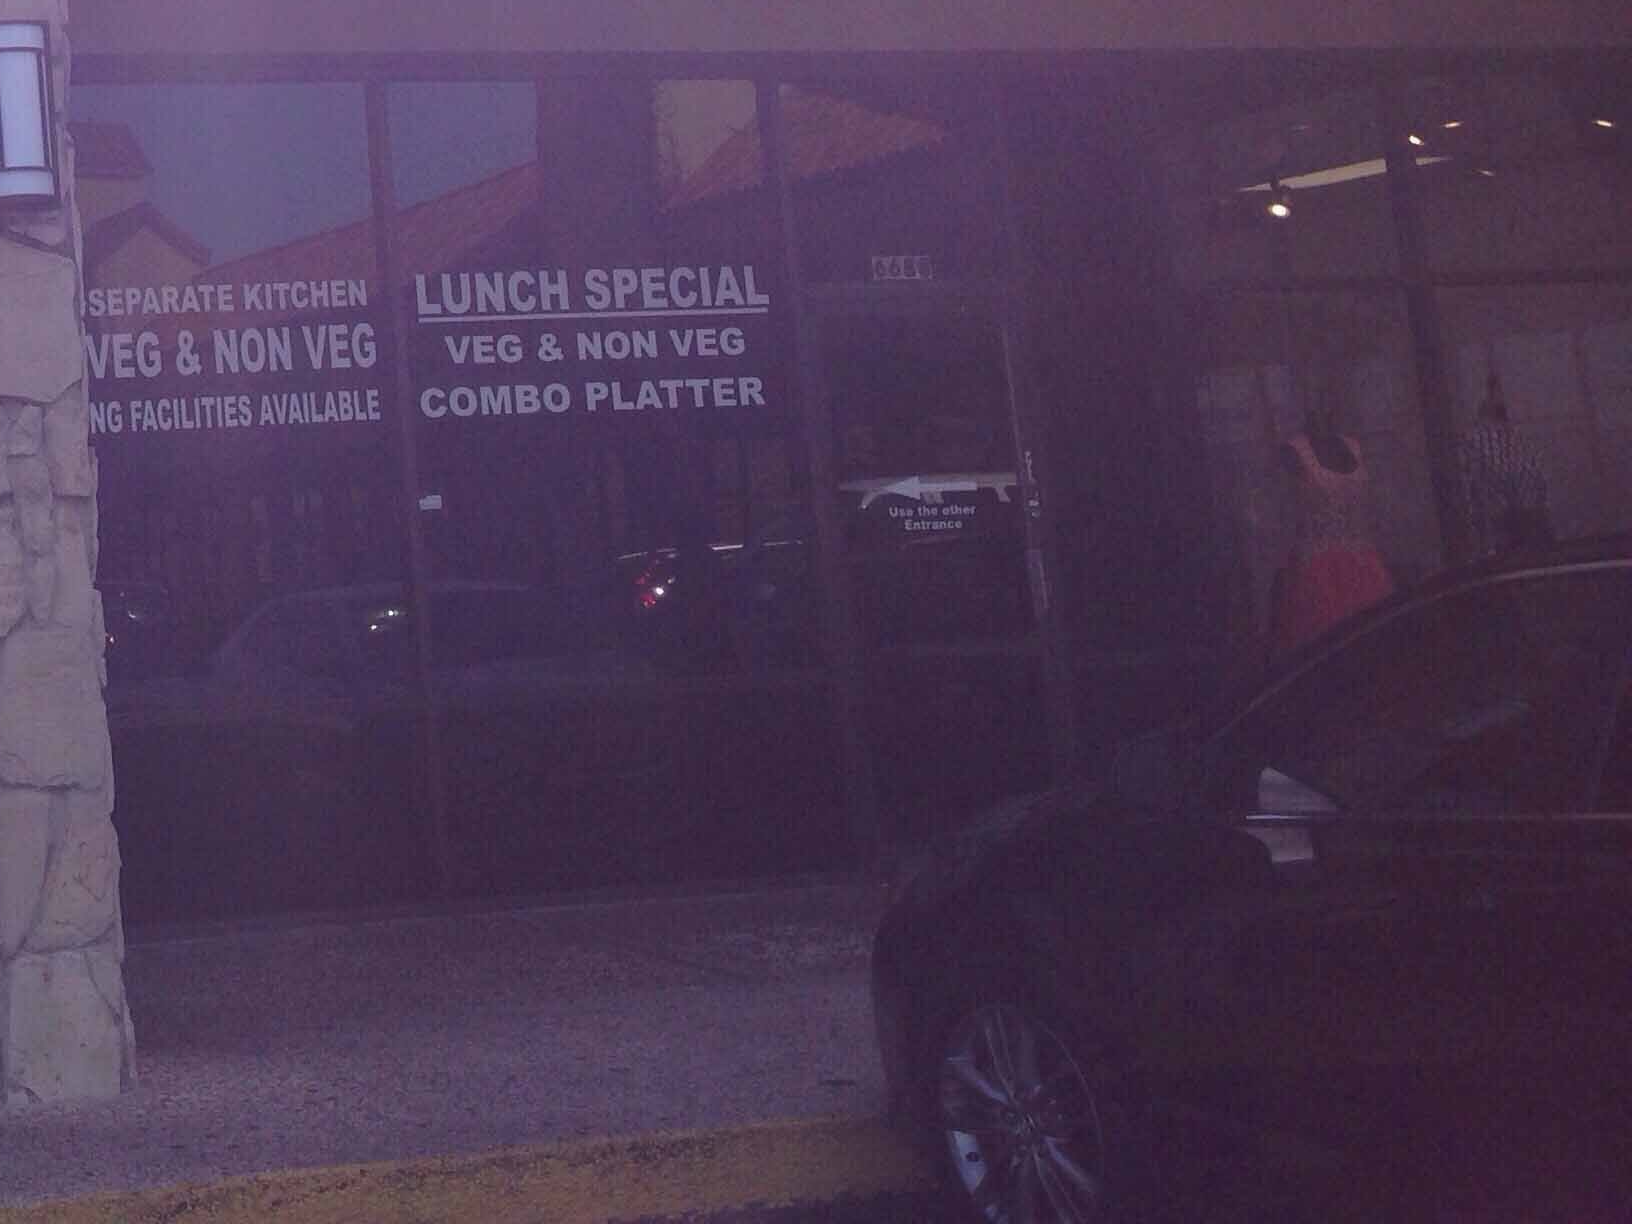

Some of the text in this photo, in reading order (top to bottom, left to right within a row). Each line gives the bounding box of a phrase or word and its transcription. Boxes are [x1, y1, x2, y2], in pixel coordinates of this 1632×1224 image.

[88, 279, 368, 317] SEPARATE KITCHEN
[416, 265, 770, 314] LUNCH SPECIAL
[85, 323, 377, 379] VEG & NON VEG
[445, 327, 745, 364] VEG & NON VEG
[130, 395, 251, 432] FACILITIES
[259, 389, 381, 426] AVAILABLE
[420, 376, 766, 418] COMBO PLATTER
[889, 505, 976, 518] Use the other
[904, 518, 962, 531] Entrance
